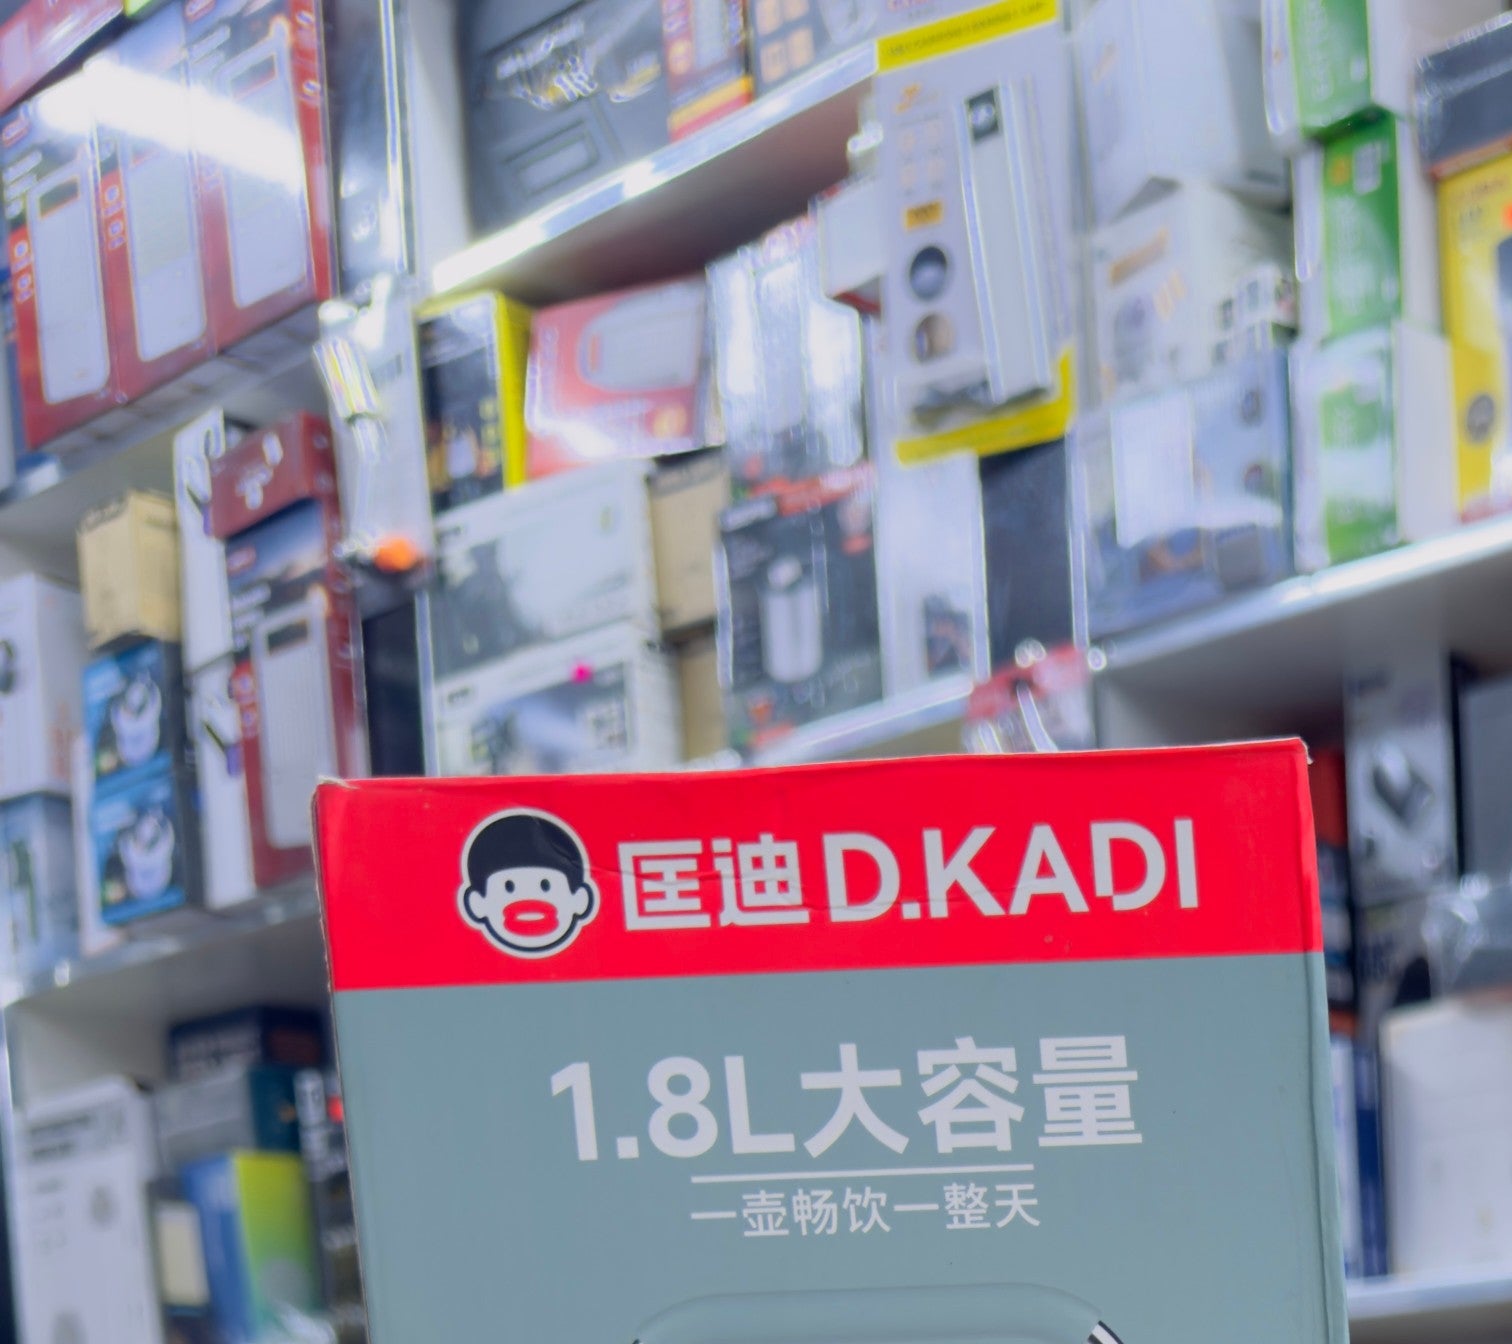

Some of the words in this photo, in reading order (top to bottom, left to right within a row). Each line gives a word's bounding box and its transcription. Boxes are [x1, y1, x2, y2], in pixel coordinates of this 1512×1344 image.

[617, 832, 810, 932] 匡迪
[822, 818, 1200, 922] D.KADI
[550, 1034, 1143, 1162] 1.8L大容量
[690, 1181, 1041, 1237] 一壶畅饮一整天
